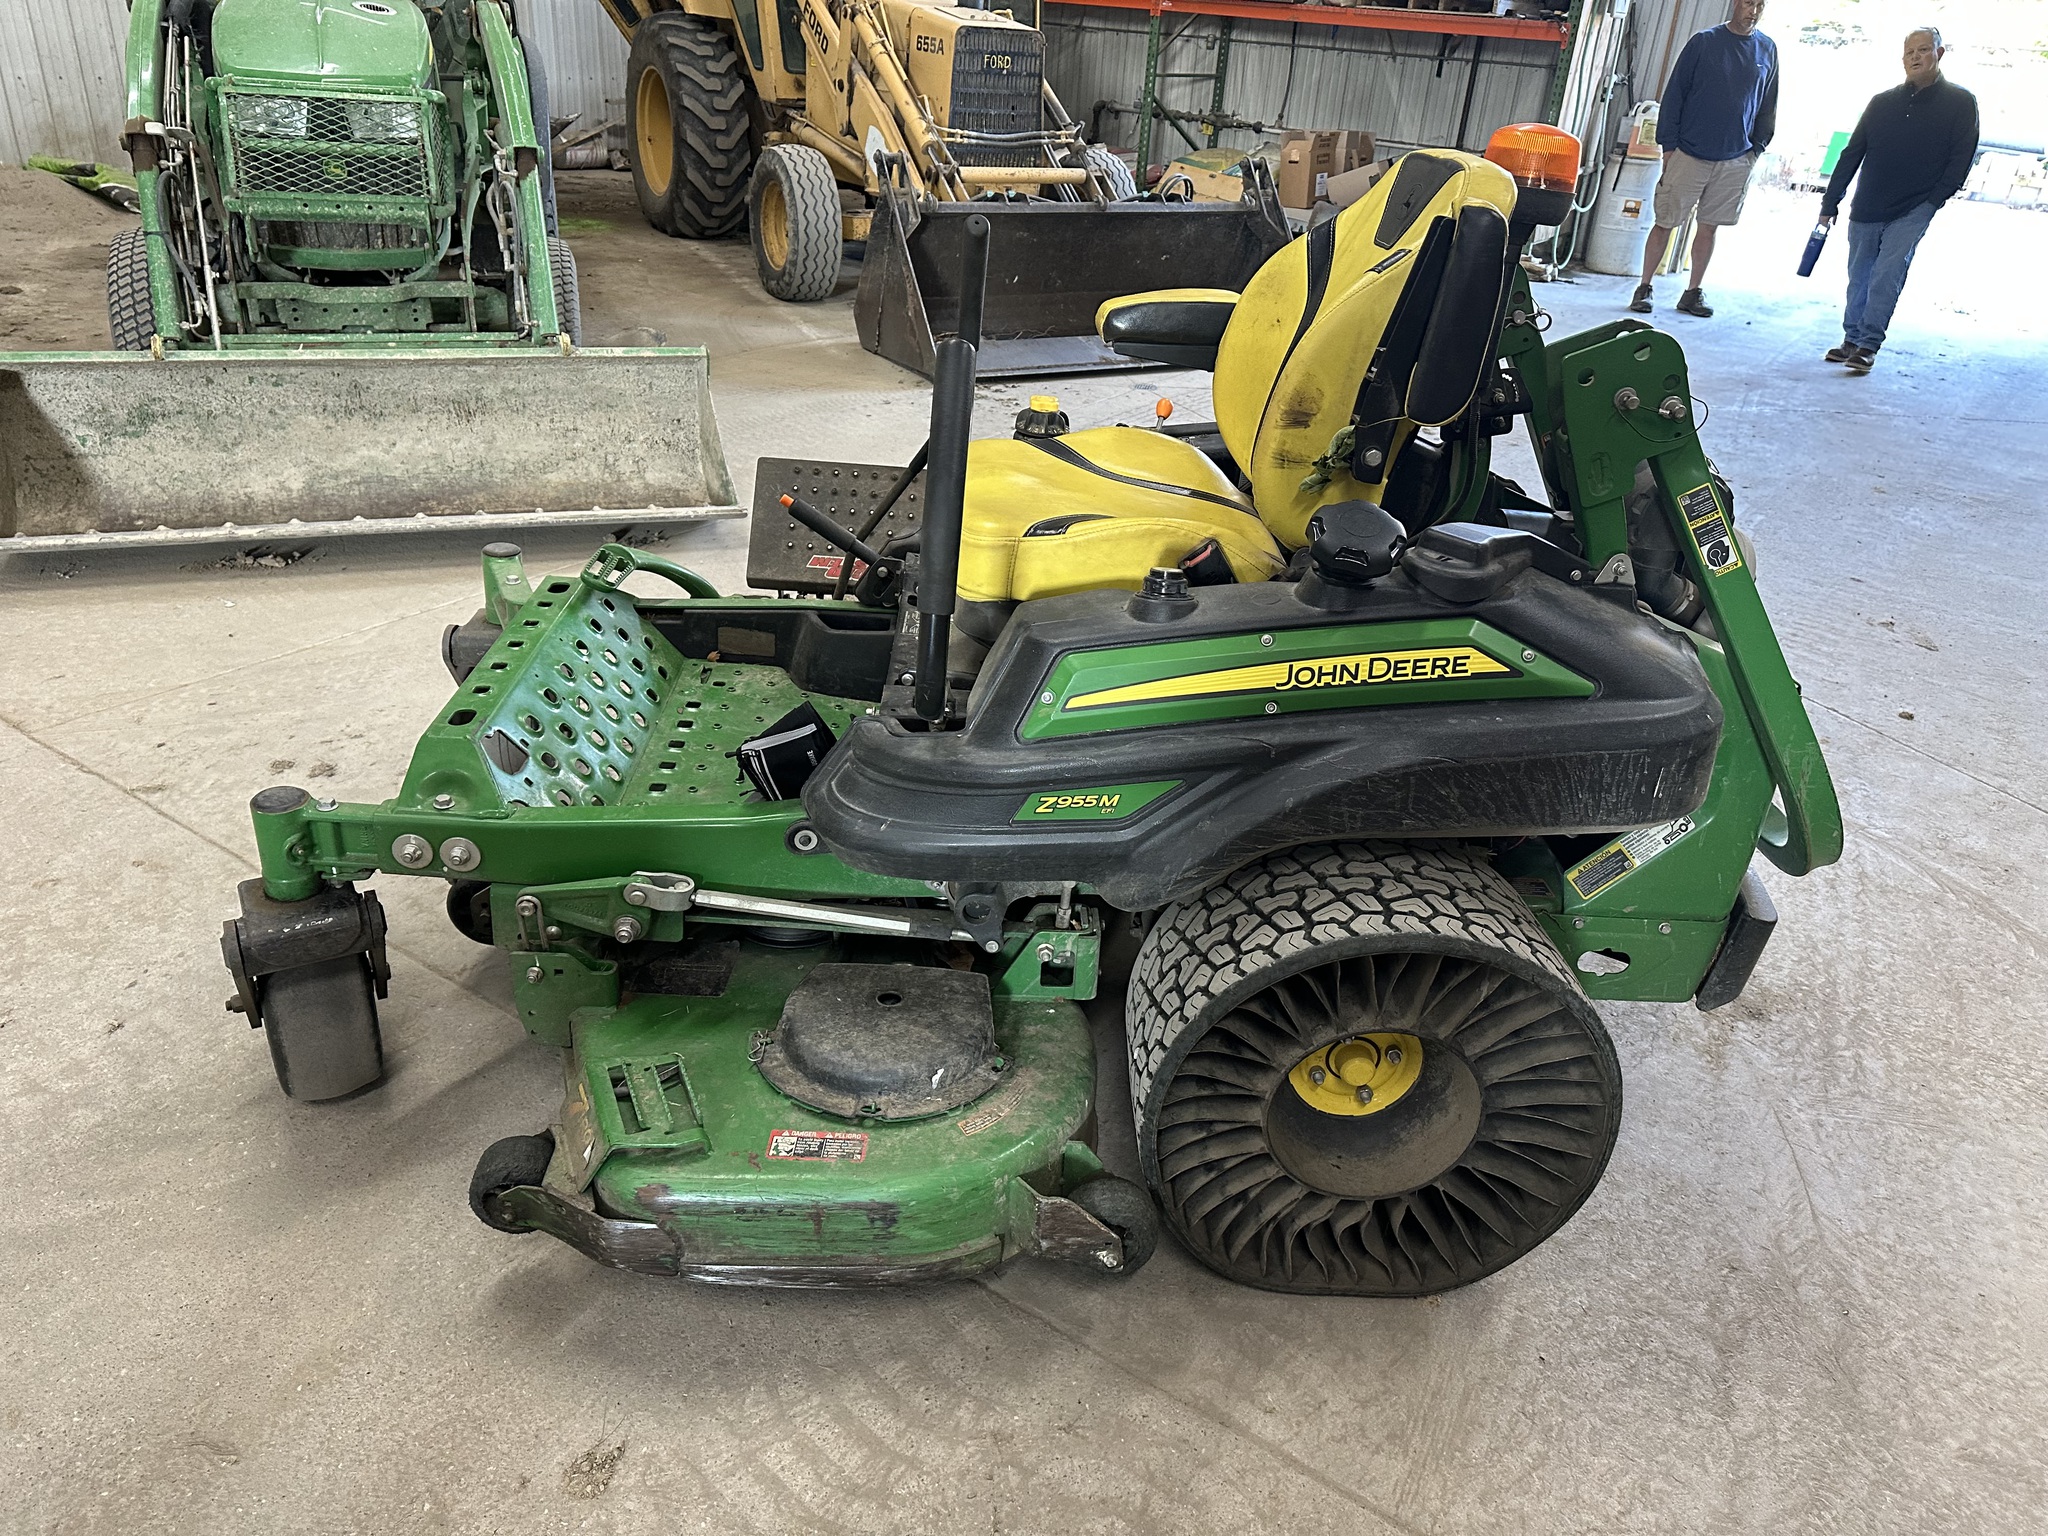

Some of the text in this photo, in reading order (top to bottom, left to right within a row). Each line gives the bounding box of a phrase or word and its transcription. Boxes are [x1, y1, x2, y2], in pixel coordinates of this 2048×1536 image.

[803, 2, 829, 54] FORD
[916, 35, 944, 55] 655A
[984, 55, 1012, 69] FORD
[1714, 563, 1735, 577] CAUTIO
[1275, 656, 1471, 688] JOHN DEERE
